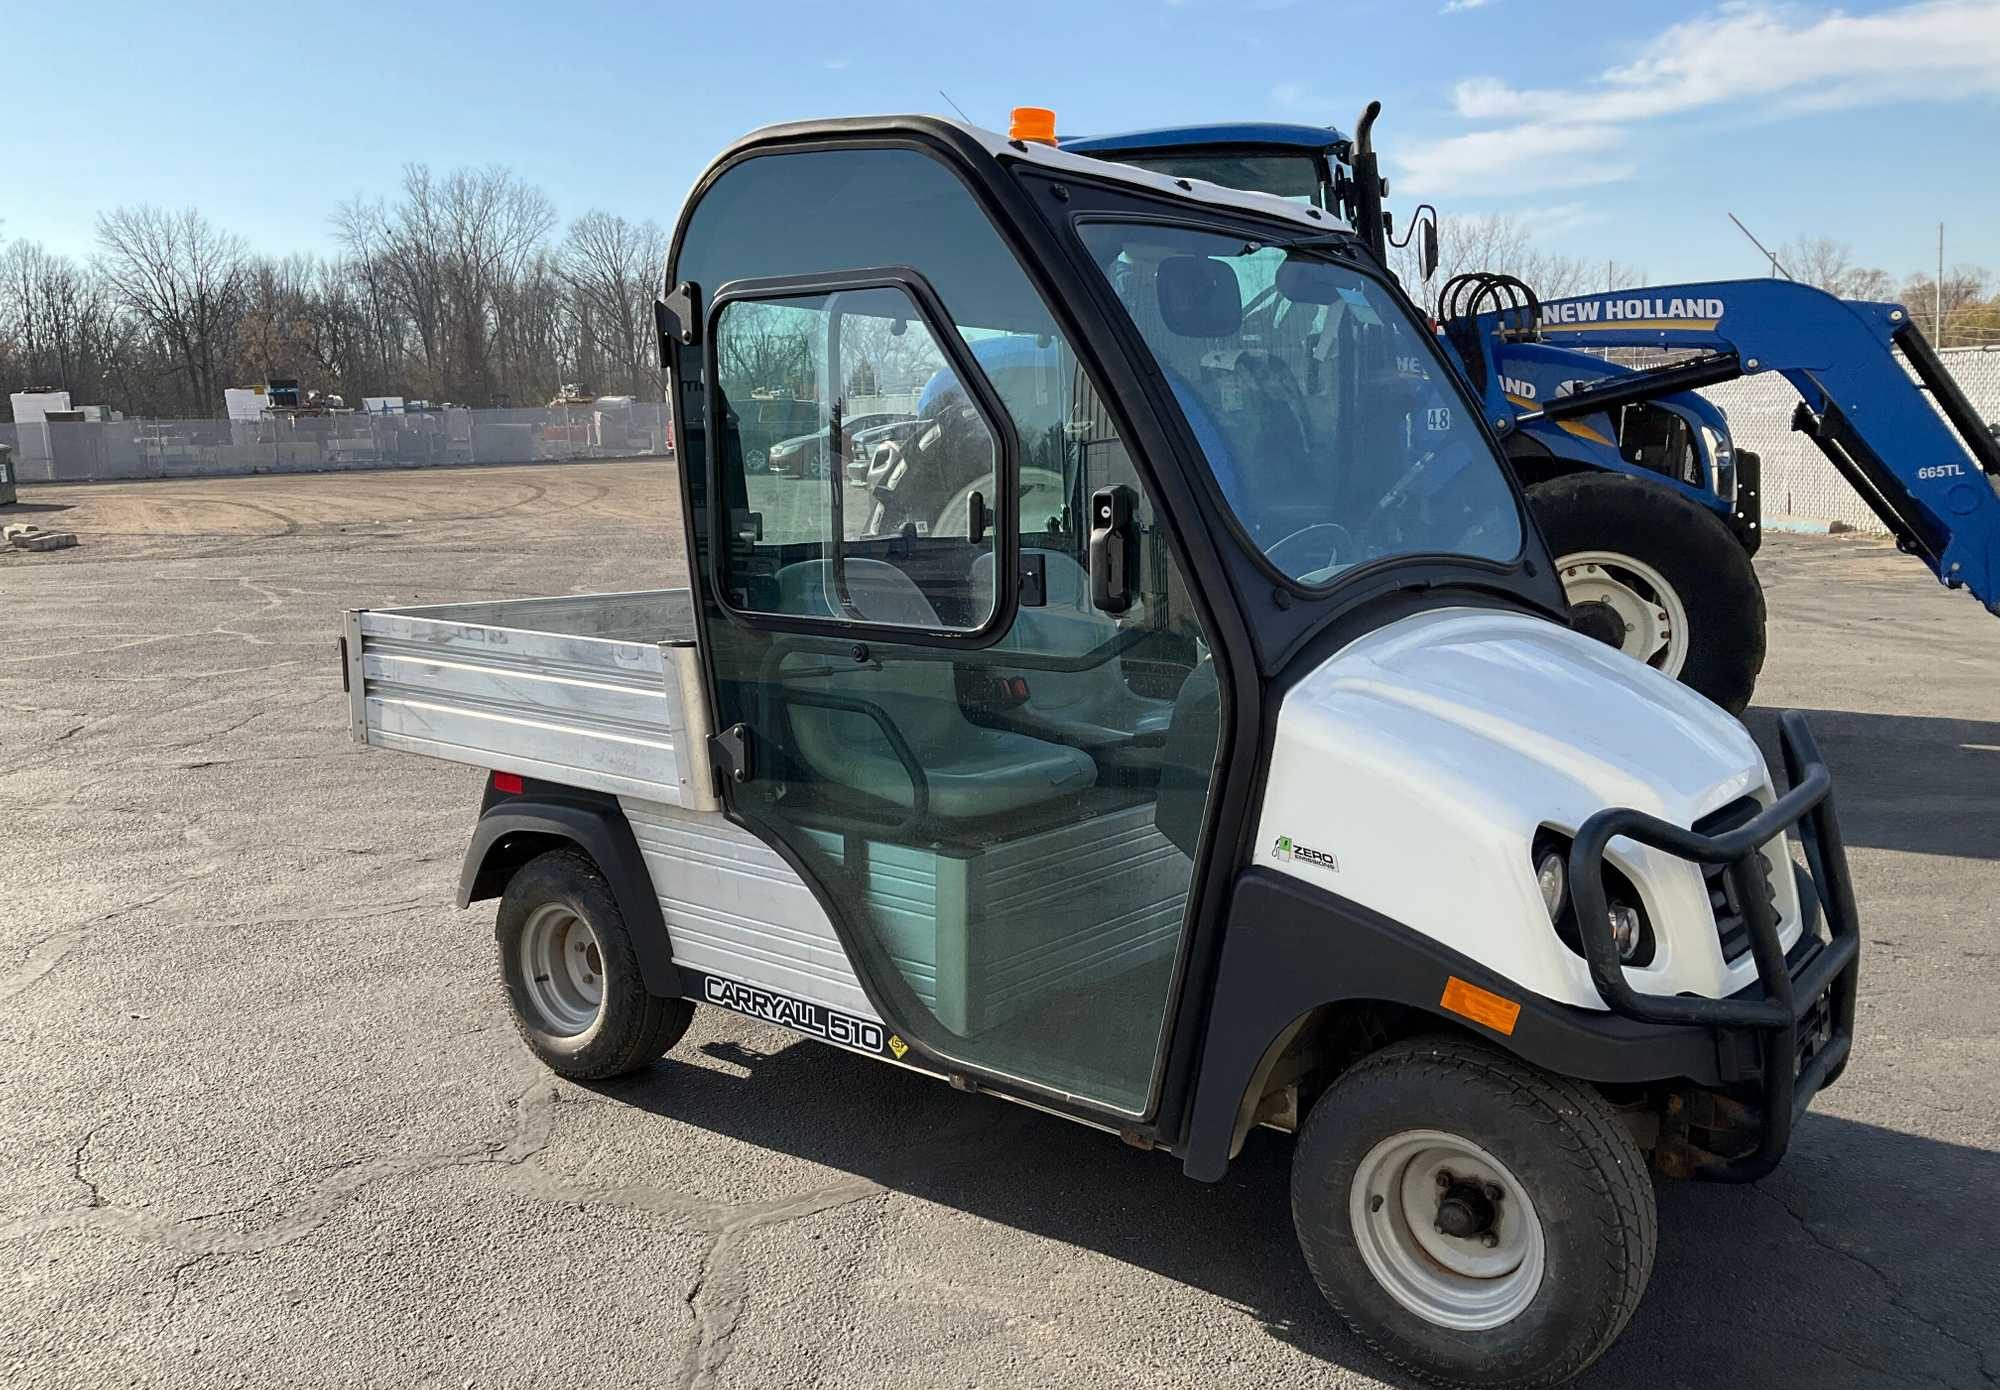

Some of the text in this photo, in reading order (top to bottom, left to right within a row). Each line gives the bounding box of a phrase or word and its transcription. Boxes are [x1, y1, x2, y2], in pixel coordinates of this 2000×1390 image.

[1542, 298, 1725, 324] NEW HOLLAND
[1428, 408, 1449, 429] 48
[1918, 464, 1966, 479] 665TL
[1293, 844, 1334, 864] ZERO
[1295, 854, 1335, 870] EMISSIONS
[704, 975, 884, 1053] CARRYALL 510
